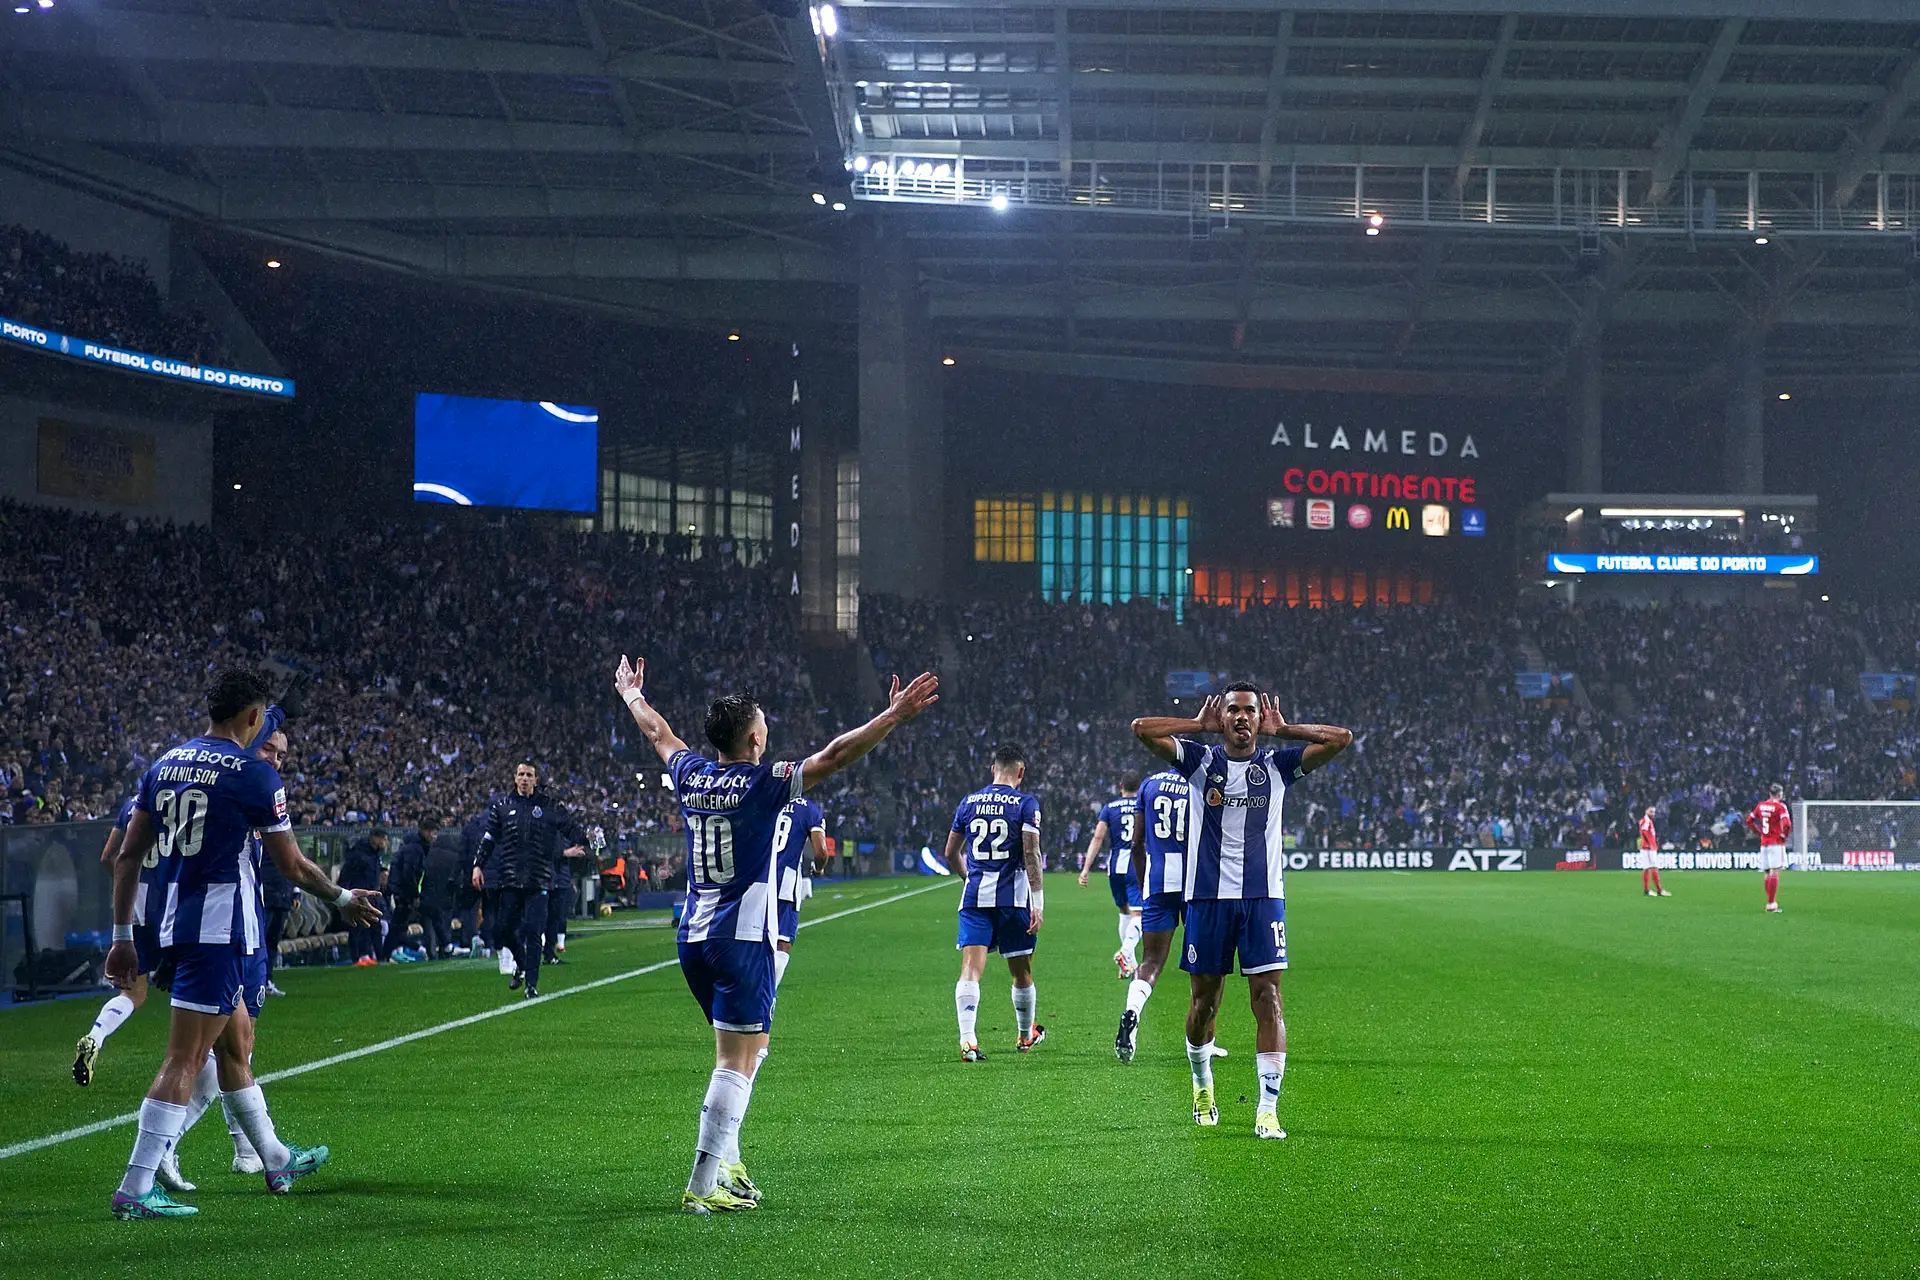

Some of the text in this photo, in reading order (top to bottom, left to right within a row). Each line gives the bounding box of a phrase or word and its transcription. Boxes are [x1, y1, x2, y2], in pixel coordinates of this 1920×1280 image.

[3, 323, 47, 345] PORTO
[84, 344, 284, 392] FUTEBOL CLUBE DO PORTO
[1271, 422, 1479, 458] ALAMEDA
[1283, 468, 1476, 503] CONTINENTE
[1597, 556, 1767, 571] FUTEBOL CLUBE DO PORTO
[158, 748, 246, 771] SUPER BOCK
[157, 766, 220, 785] EVANILSON
[1150, 772, 1180, 782] SUPER
[966, 793, 1021, 805] SUPER BOCK
[1159, 781, 1188, 796] OTAVIO
[976, 805, 1004, 815] VARELA
[1220, 796, 1267, 808] BETANO
[155, 789, 208, 857] 30
[1121, 814, 1135, 842] 3
[1154, 796, 1188, 842] 31
[1762, 817, 1769, 834] 5
[687, 815, 735, 884] 10
[970, 818, 1009, 860] 22
[1319, 851, 1433, 868] FERRAGENS
[1448, 850, 1522, 870] ATZ
[1622, 852, 1678, 869] DESBRE
[1679, 852, 1694, 869] OS
[1695, 852, 1732, 869] NOVOS
[1270, 921, 1286, 948] 13
